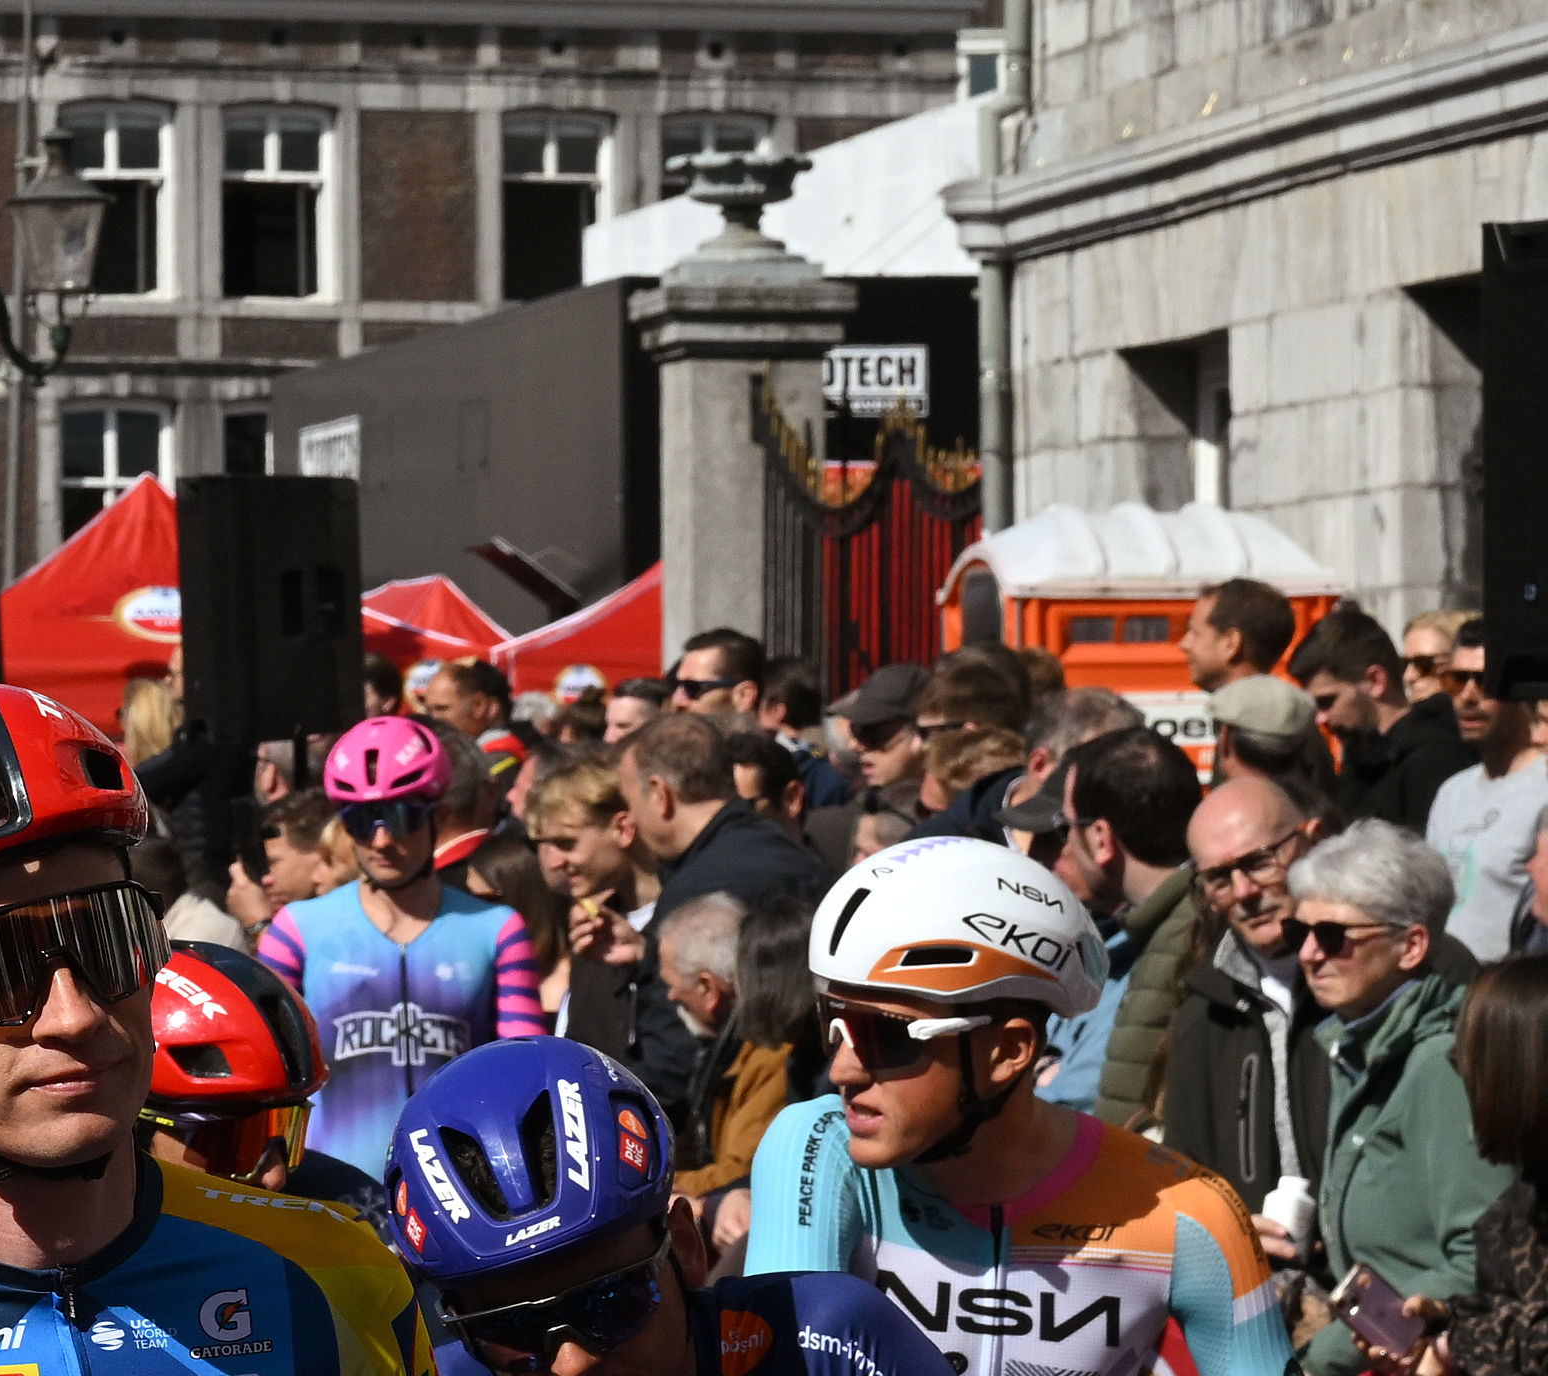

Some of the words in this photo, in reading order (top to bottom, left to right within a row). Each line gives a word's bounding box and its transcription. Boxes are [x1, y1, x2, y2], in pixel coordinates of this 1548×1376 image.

[565, 1078, 591, 1191] LAZER
[408, 1129, 473, 1224] LAZER
[505, 1215, 562, 1248] LAZER
[132, 1327, 178, 1342] WORLD
[133, 1336, 169, 1351] TEAM
[190, 1339, 273, 1360] GATORADE
